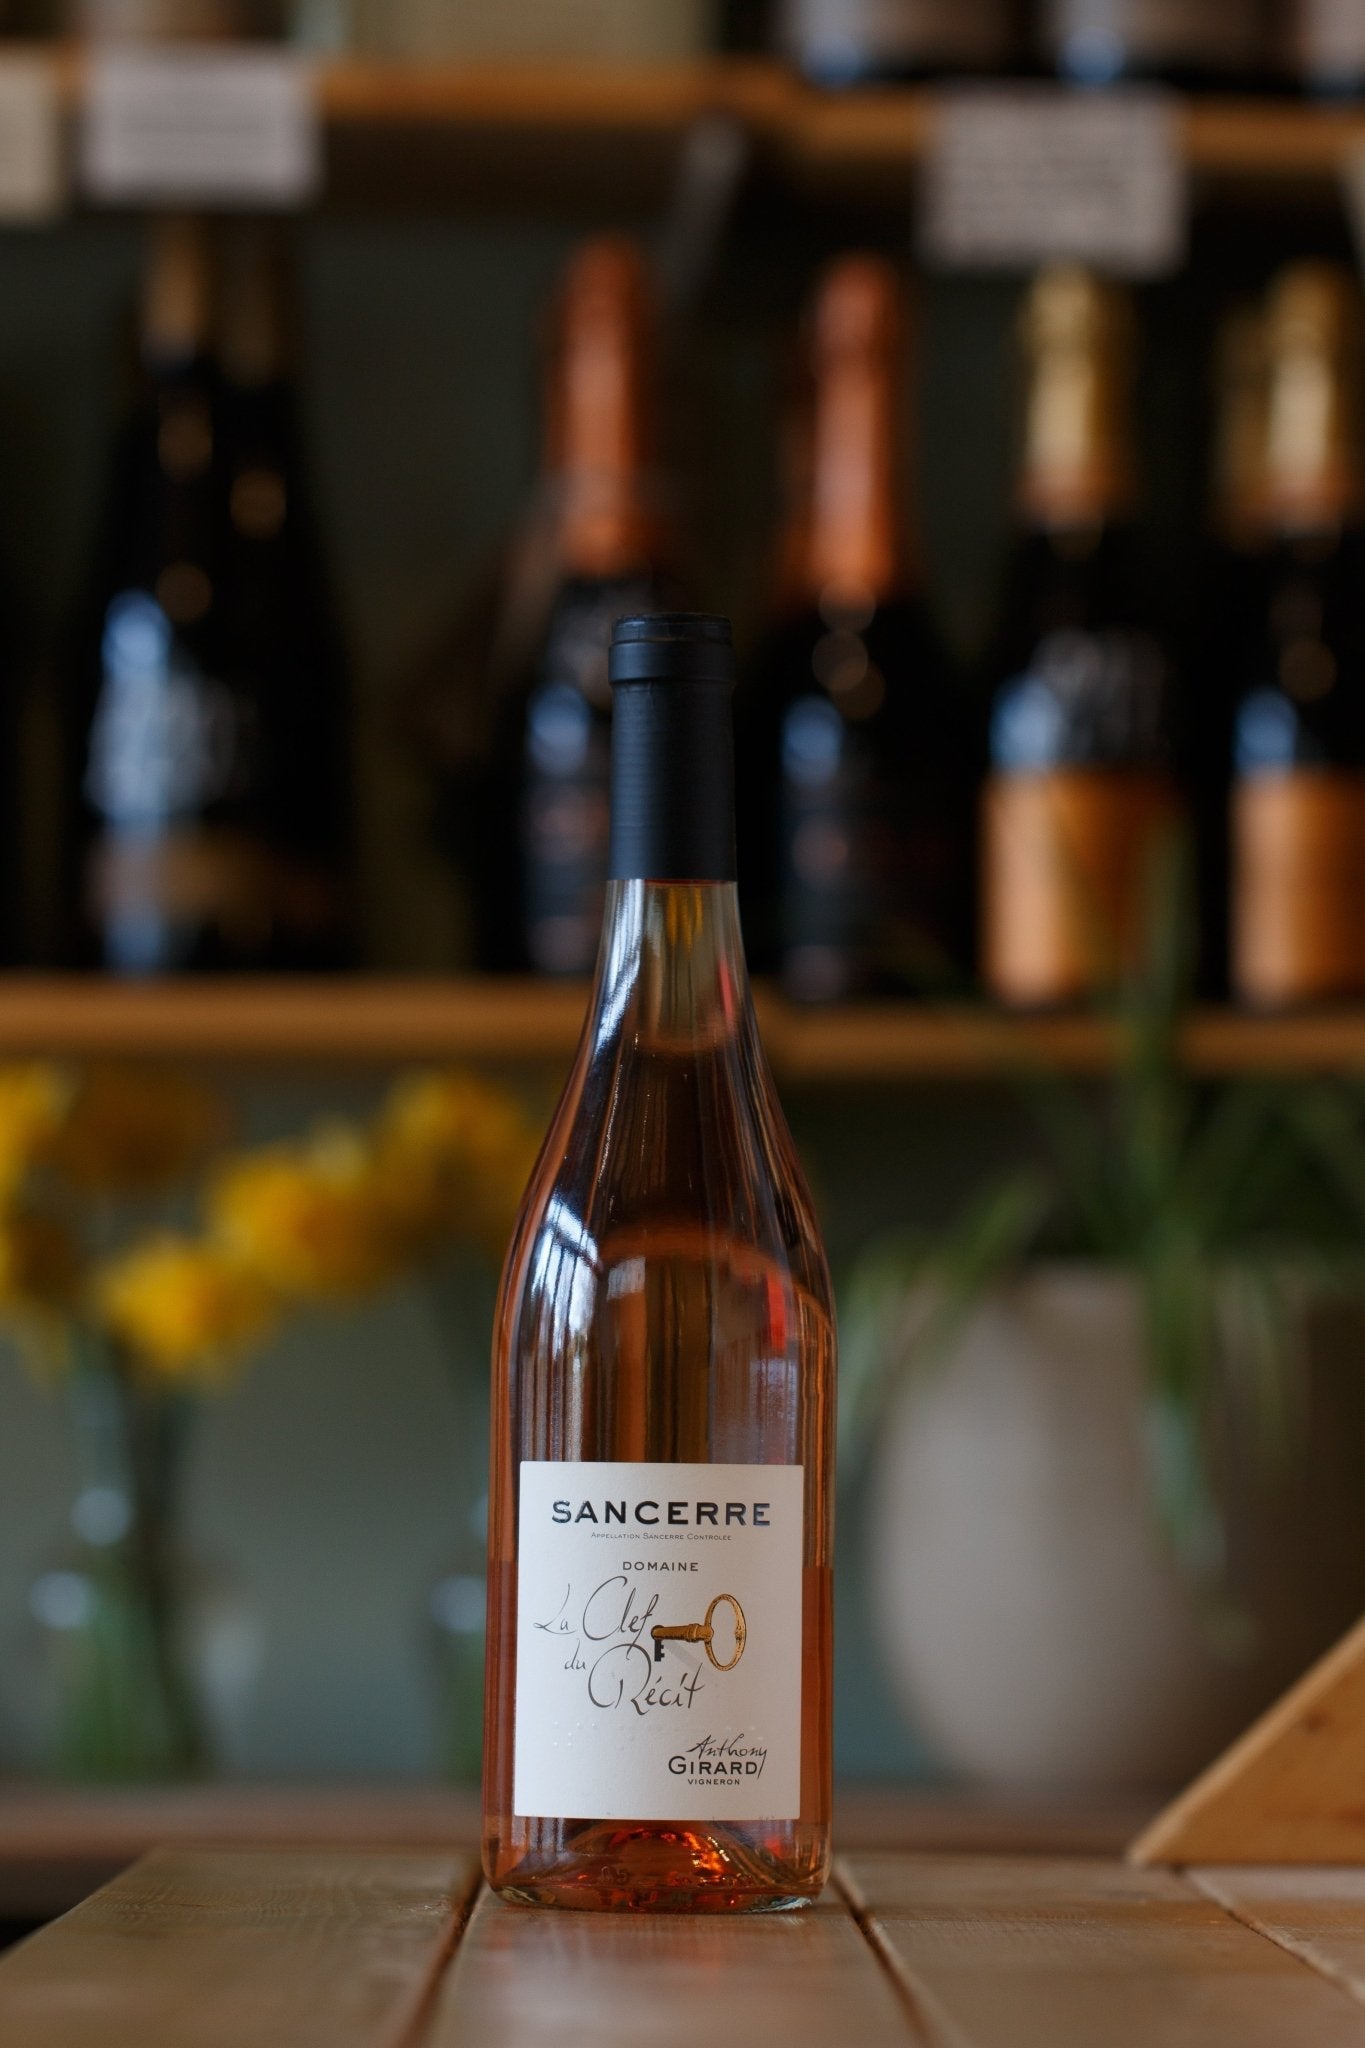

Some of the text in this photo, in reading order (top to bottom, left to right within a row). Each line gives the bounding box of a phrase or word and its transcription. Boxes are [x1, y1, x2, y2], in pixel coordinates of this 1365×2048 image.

[551, 1500, 771, 1527] SANCERRE
[623, 1561, 699, 1572] DOMAINE
[533, 1575, 659, 1660] La Clef
[564, 1638, 705, 1716] du Récit
[668, 1755, 758, 1775] GIRARD
[686, 1733, 768, 1779] Anthony
[688, 1778, 740, 1786] VIGNERON
